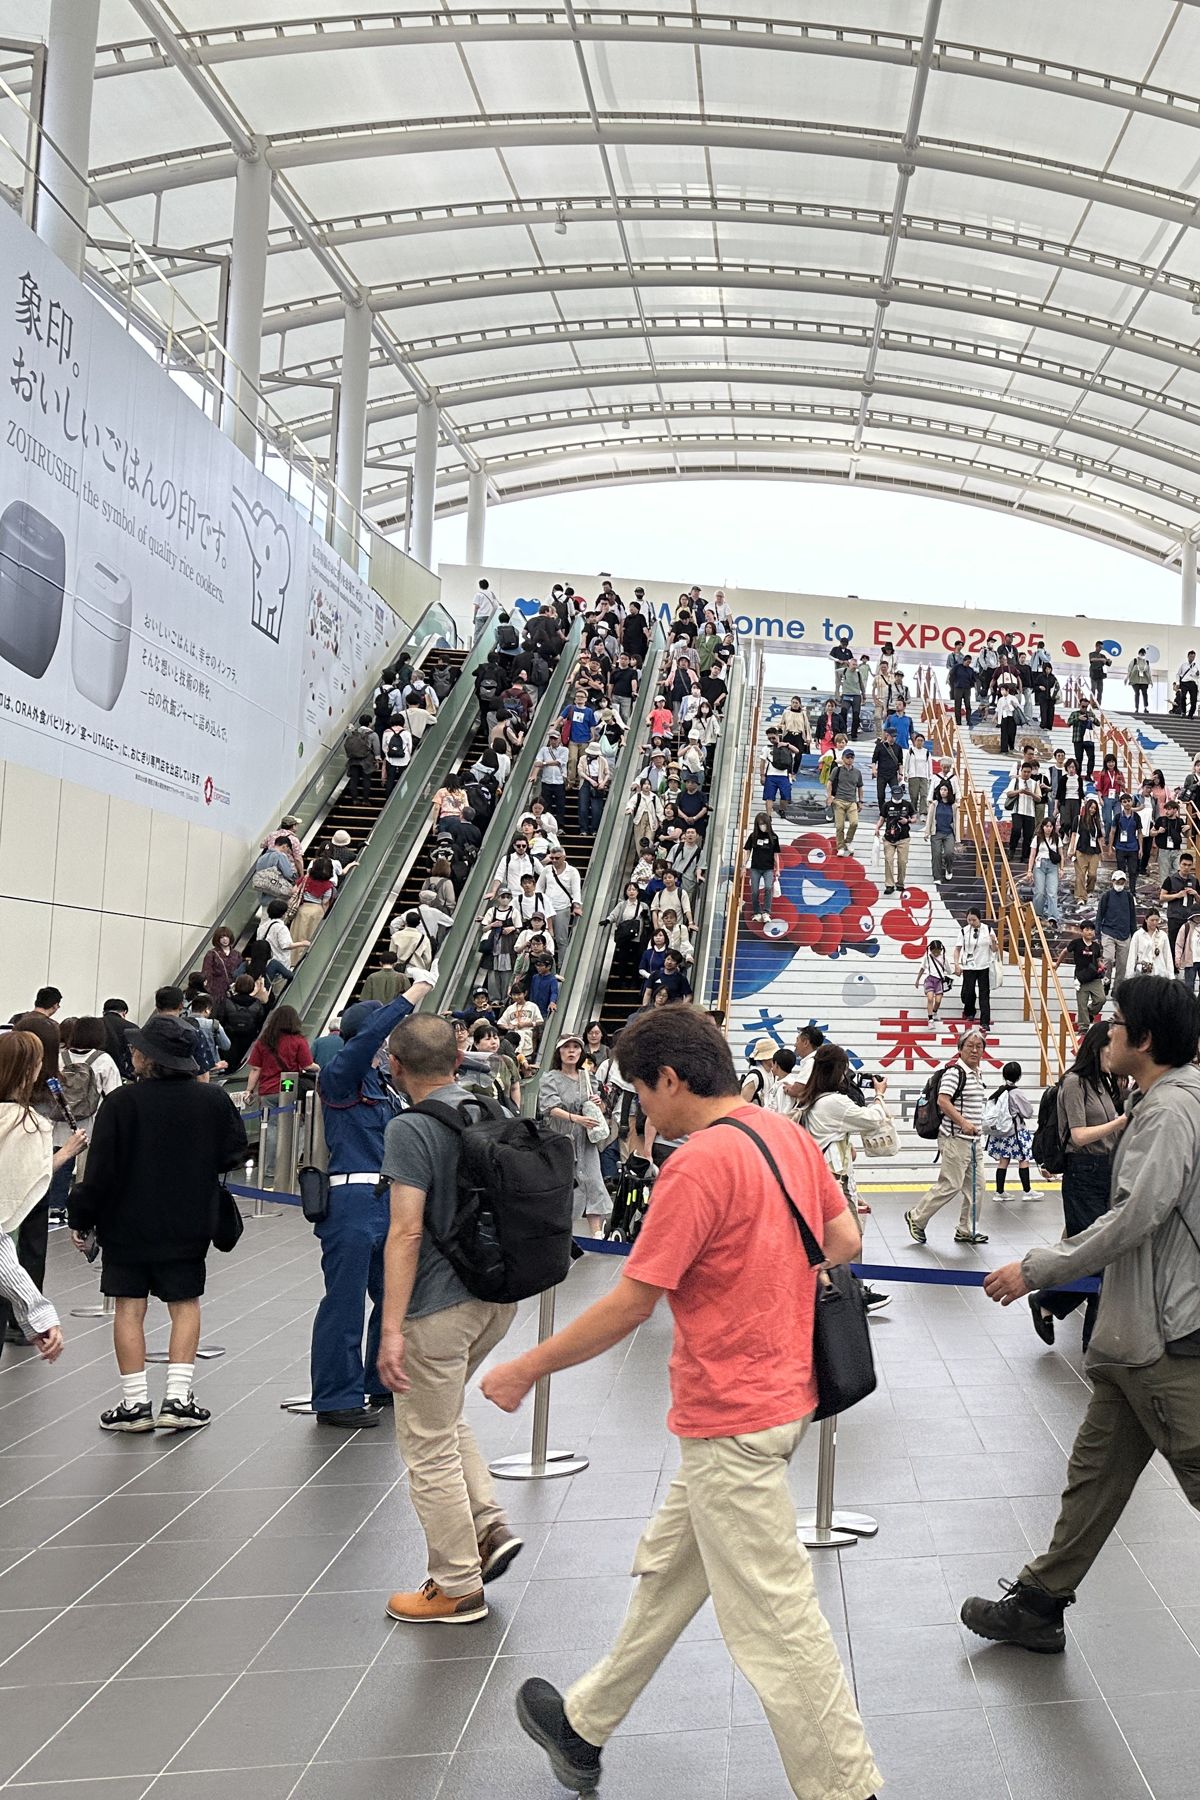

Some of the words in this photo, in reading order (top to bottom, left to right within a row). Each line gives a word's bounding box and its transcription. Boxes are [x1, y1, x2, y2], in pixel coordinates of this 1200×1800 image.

[16, 271, 79, 378] 象印。
[7, 420, 79, 498] ZOJIRUSHI,
[83, 481, 99, 509] the
[102, 500, 135, 537] symbol
[138, 525, 148, 545] of
[149, 536, 178, 570] quality
[179, 556, 194, 581] rice
[10, 346, 227, 569] おいしいごはんの印です。
[823, 618, 854, 641] to
